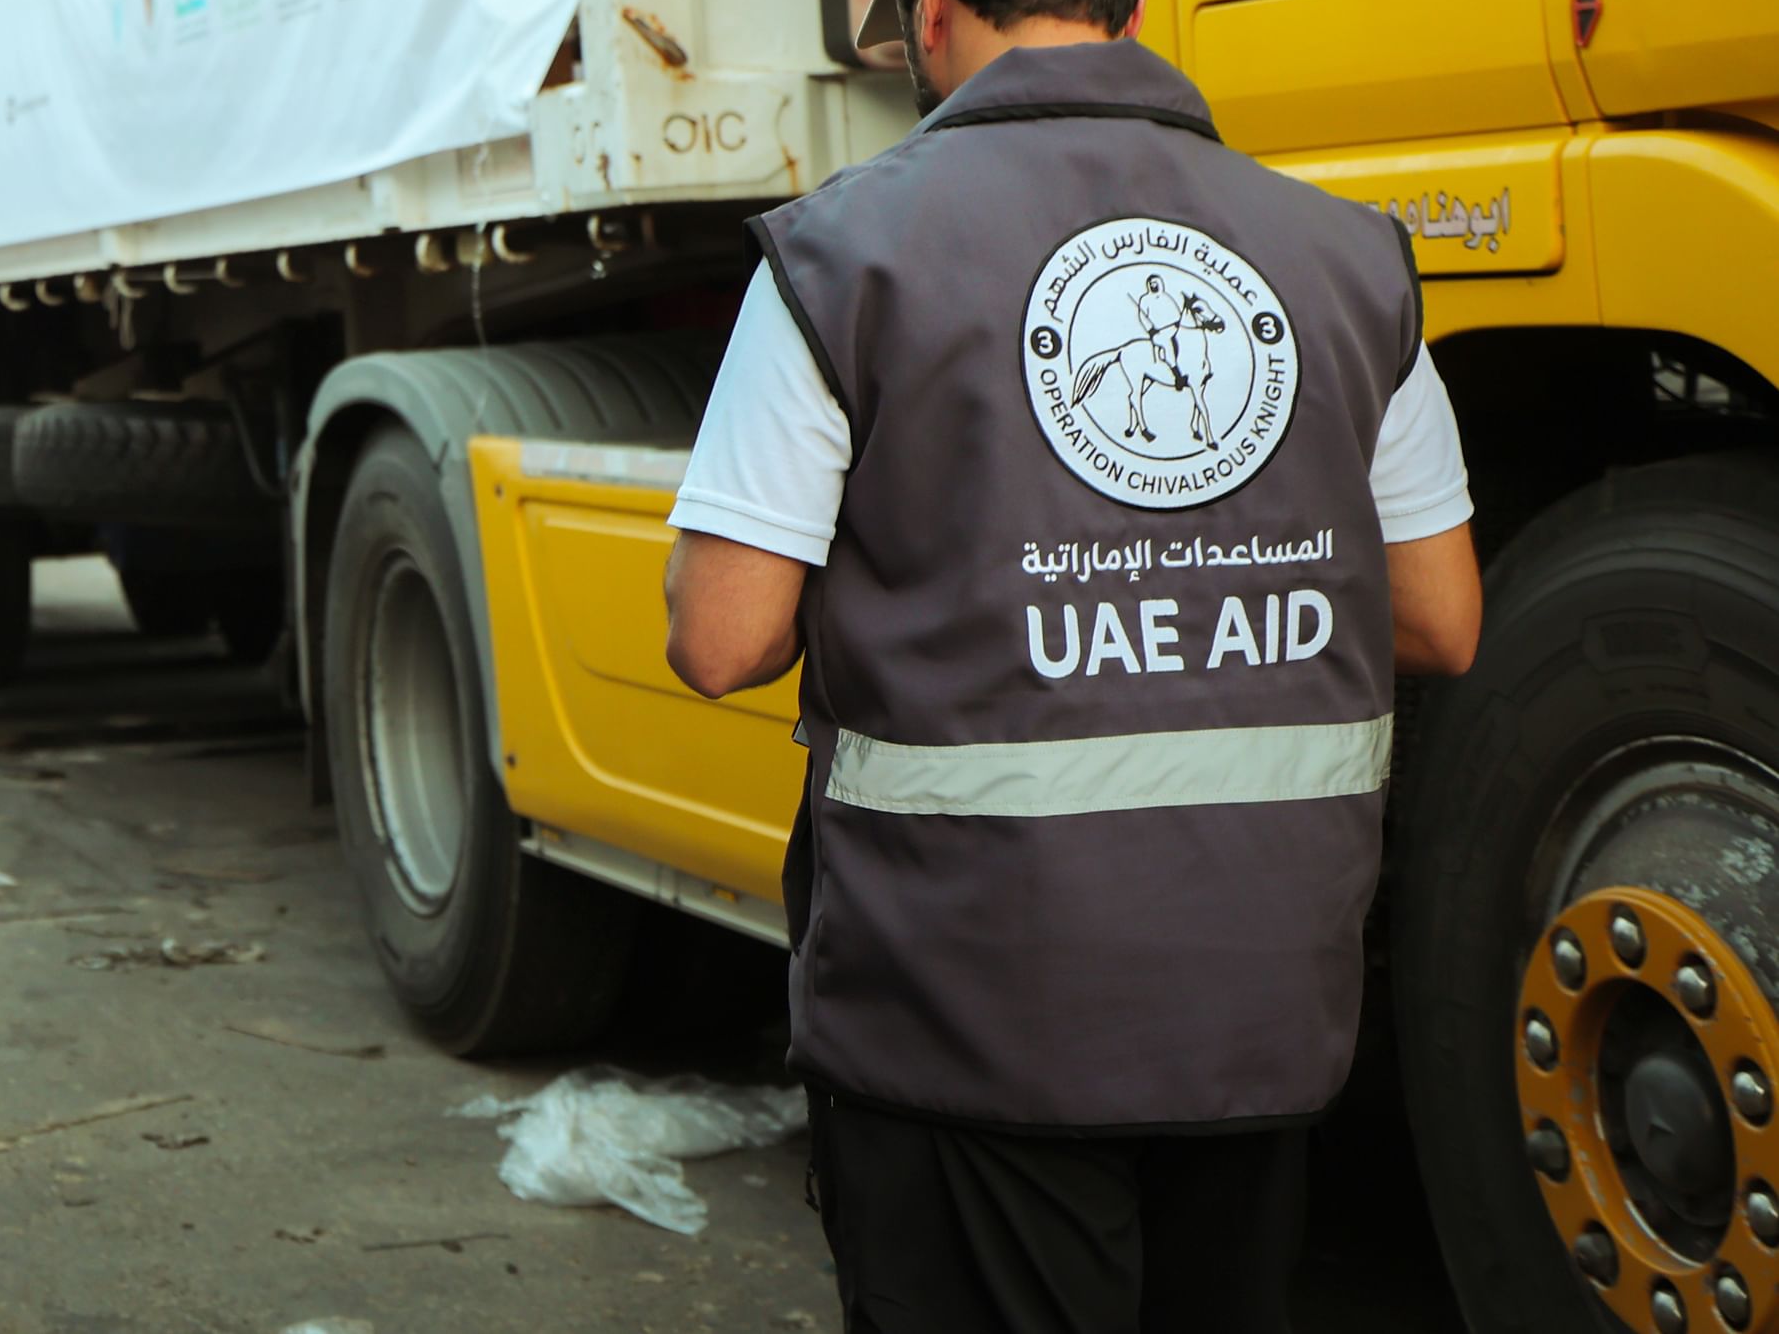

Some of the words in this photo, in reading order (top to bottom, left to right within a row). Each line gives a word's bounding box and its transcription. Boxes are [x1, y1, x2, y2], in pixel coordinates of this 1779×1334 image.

[1102, 227, 1189, 259] الفارس
[1194, 243, 1258, 306] عملية
[1044, 240, 1097, 324] الشهم
[1040, 369, 1125, 483] OPERATION
[1126, 439, 1257, 494] CHIVALROUS
[1252, 353, 1286, 440] KNIGHT
[1021, 539, 1152, 583] الإماراتية
[1160, 528, 1333, 568] المساعدات
[1026, 598, 1185, 679] UAE
[1206, 589, 1334, 669] AID
